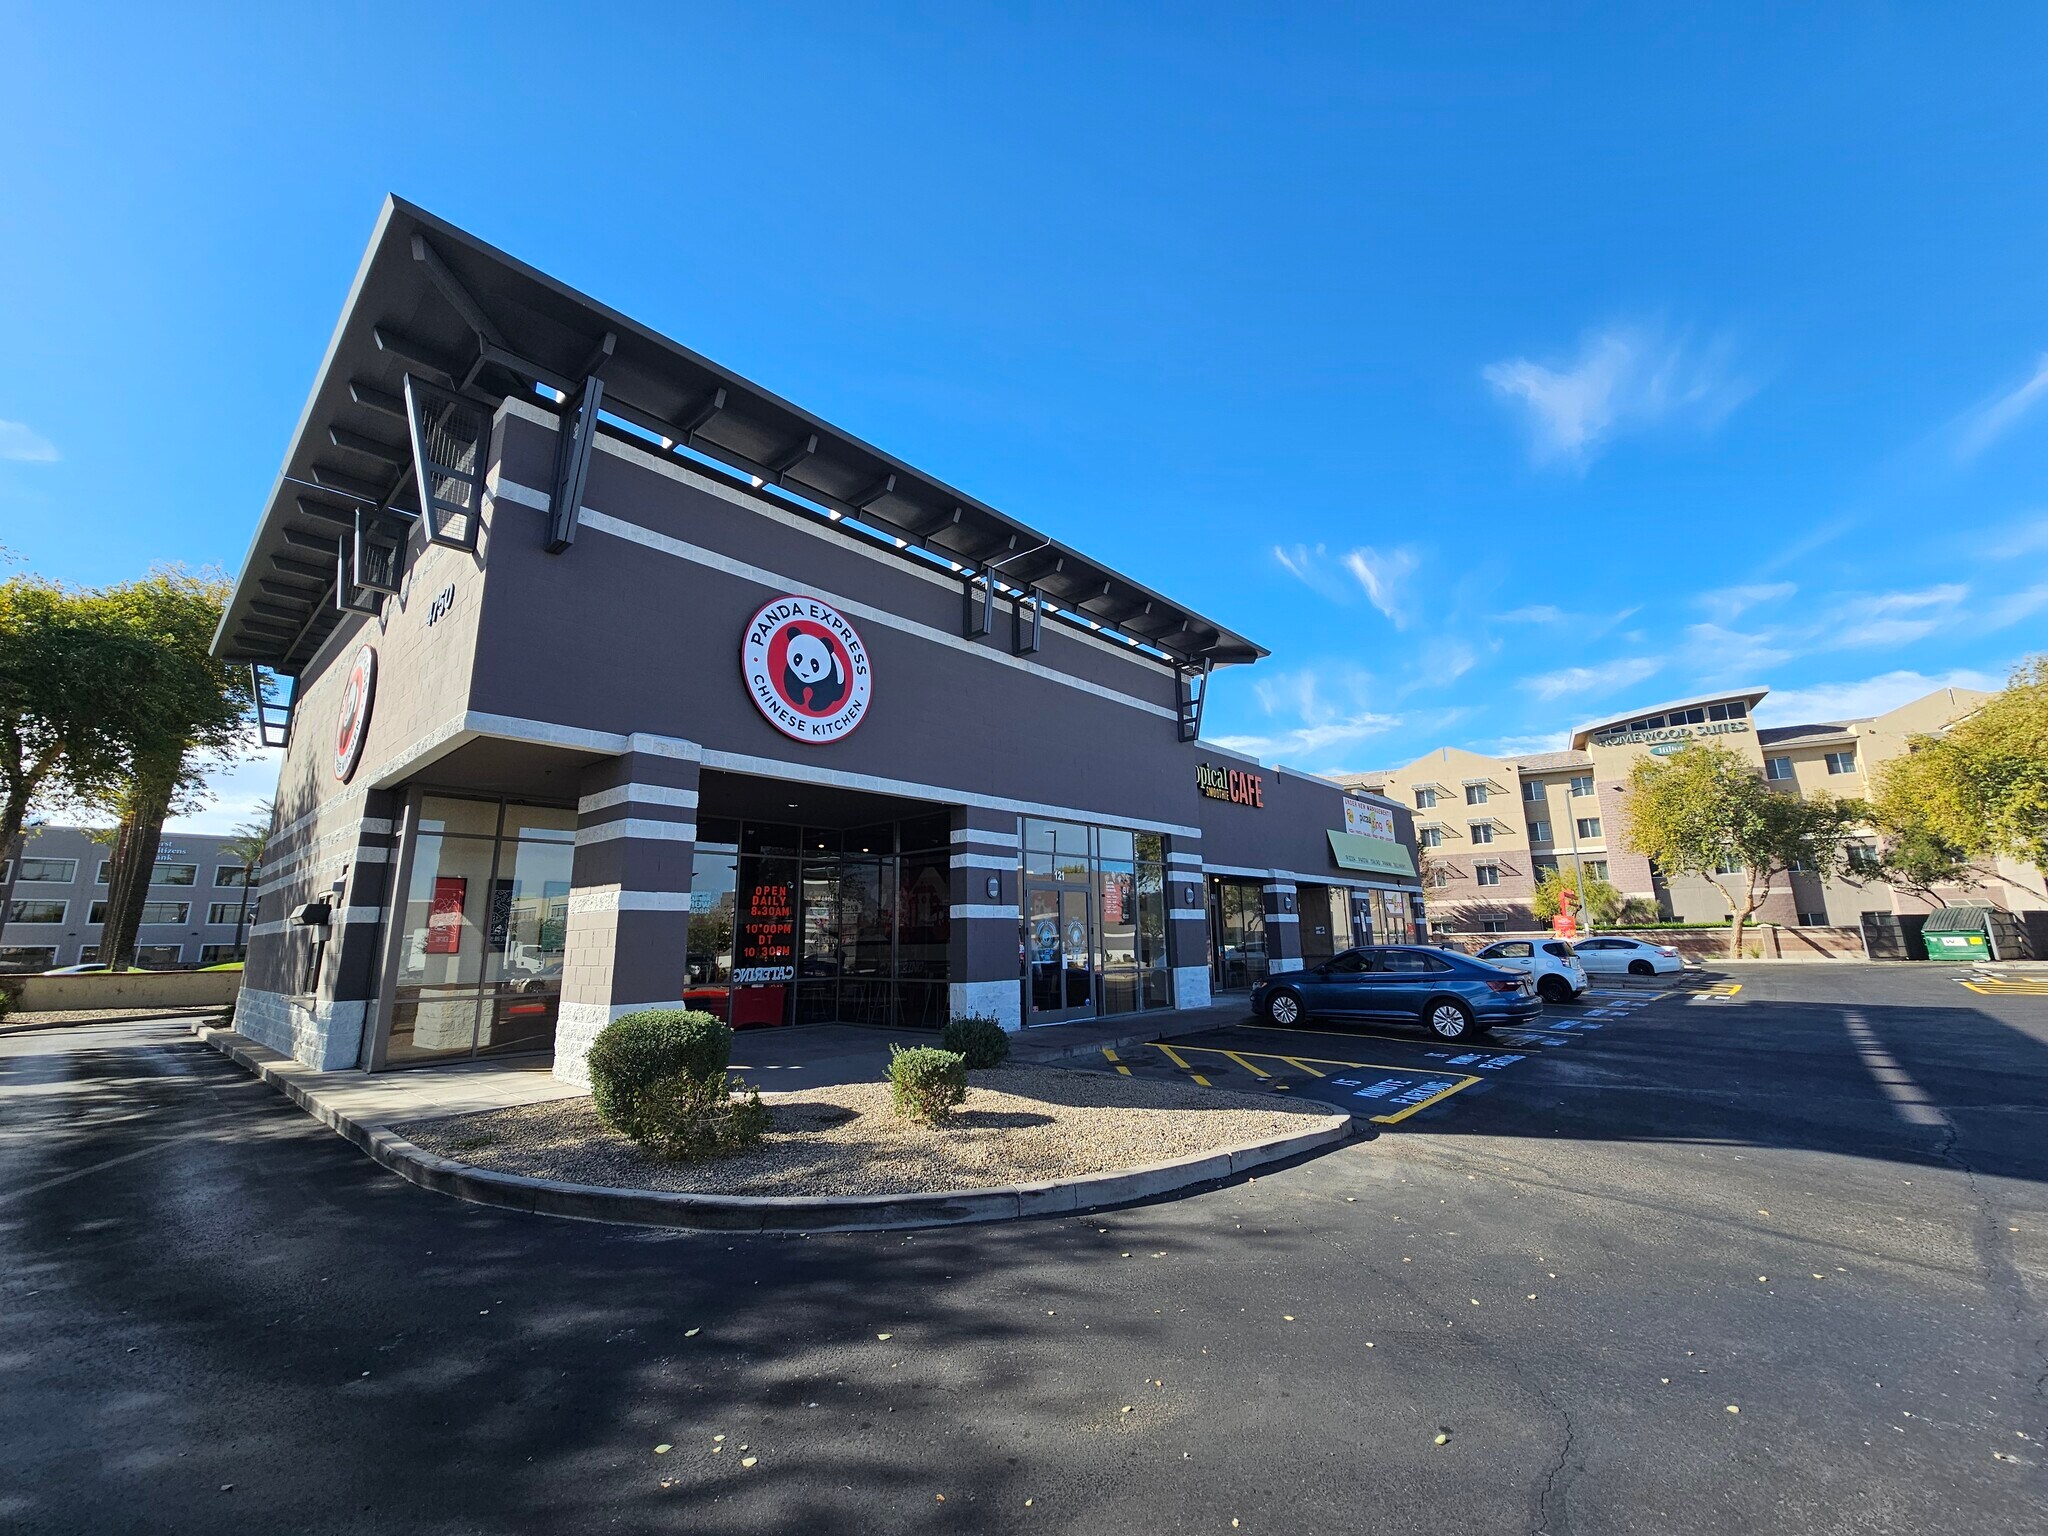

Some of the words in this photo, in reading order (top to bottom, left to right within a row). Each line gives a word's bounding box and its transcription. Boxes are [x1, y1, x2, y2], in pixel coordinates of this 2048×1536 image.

[427, 582, 455, 627] 4750
[750, 602, 805, 646] PANDA
[810, 604, 867, 676] EXPRESS
[754, 674, 806, 732] CHINESE
[812, 700, 863, 735] KITCHEN
[1696, 720, 1748, 736] SUITES
[1195, 762, 1229, 789] pical
[1229, 769, 1264, 808] CAFE
[155, 853, 173, 861] ank
[157, 846, 187, 854] itizens
[1054, 870, 1065, 881] 121
[752, 895, 787, 906] DAILY
[755, 885, 787, 896] OPEN
[1352, 1078, 1412, 1099] MINUTE
[1389, 1081, 1453, 1105] PARKING
